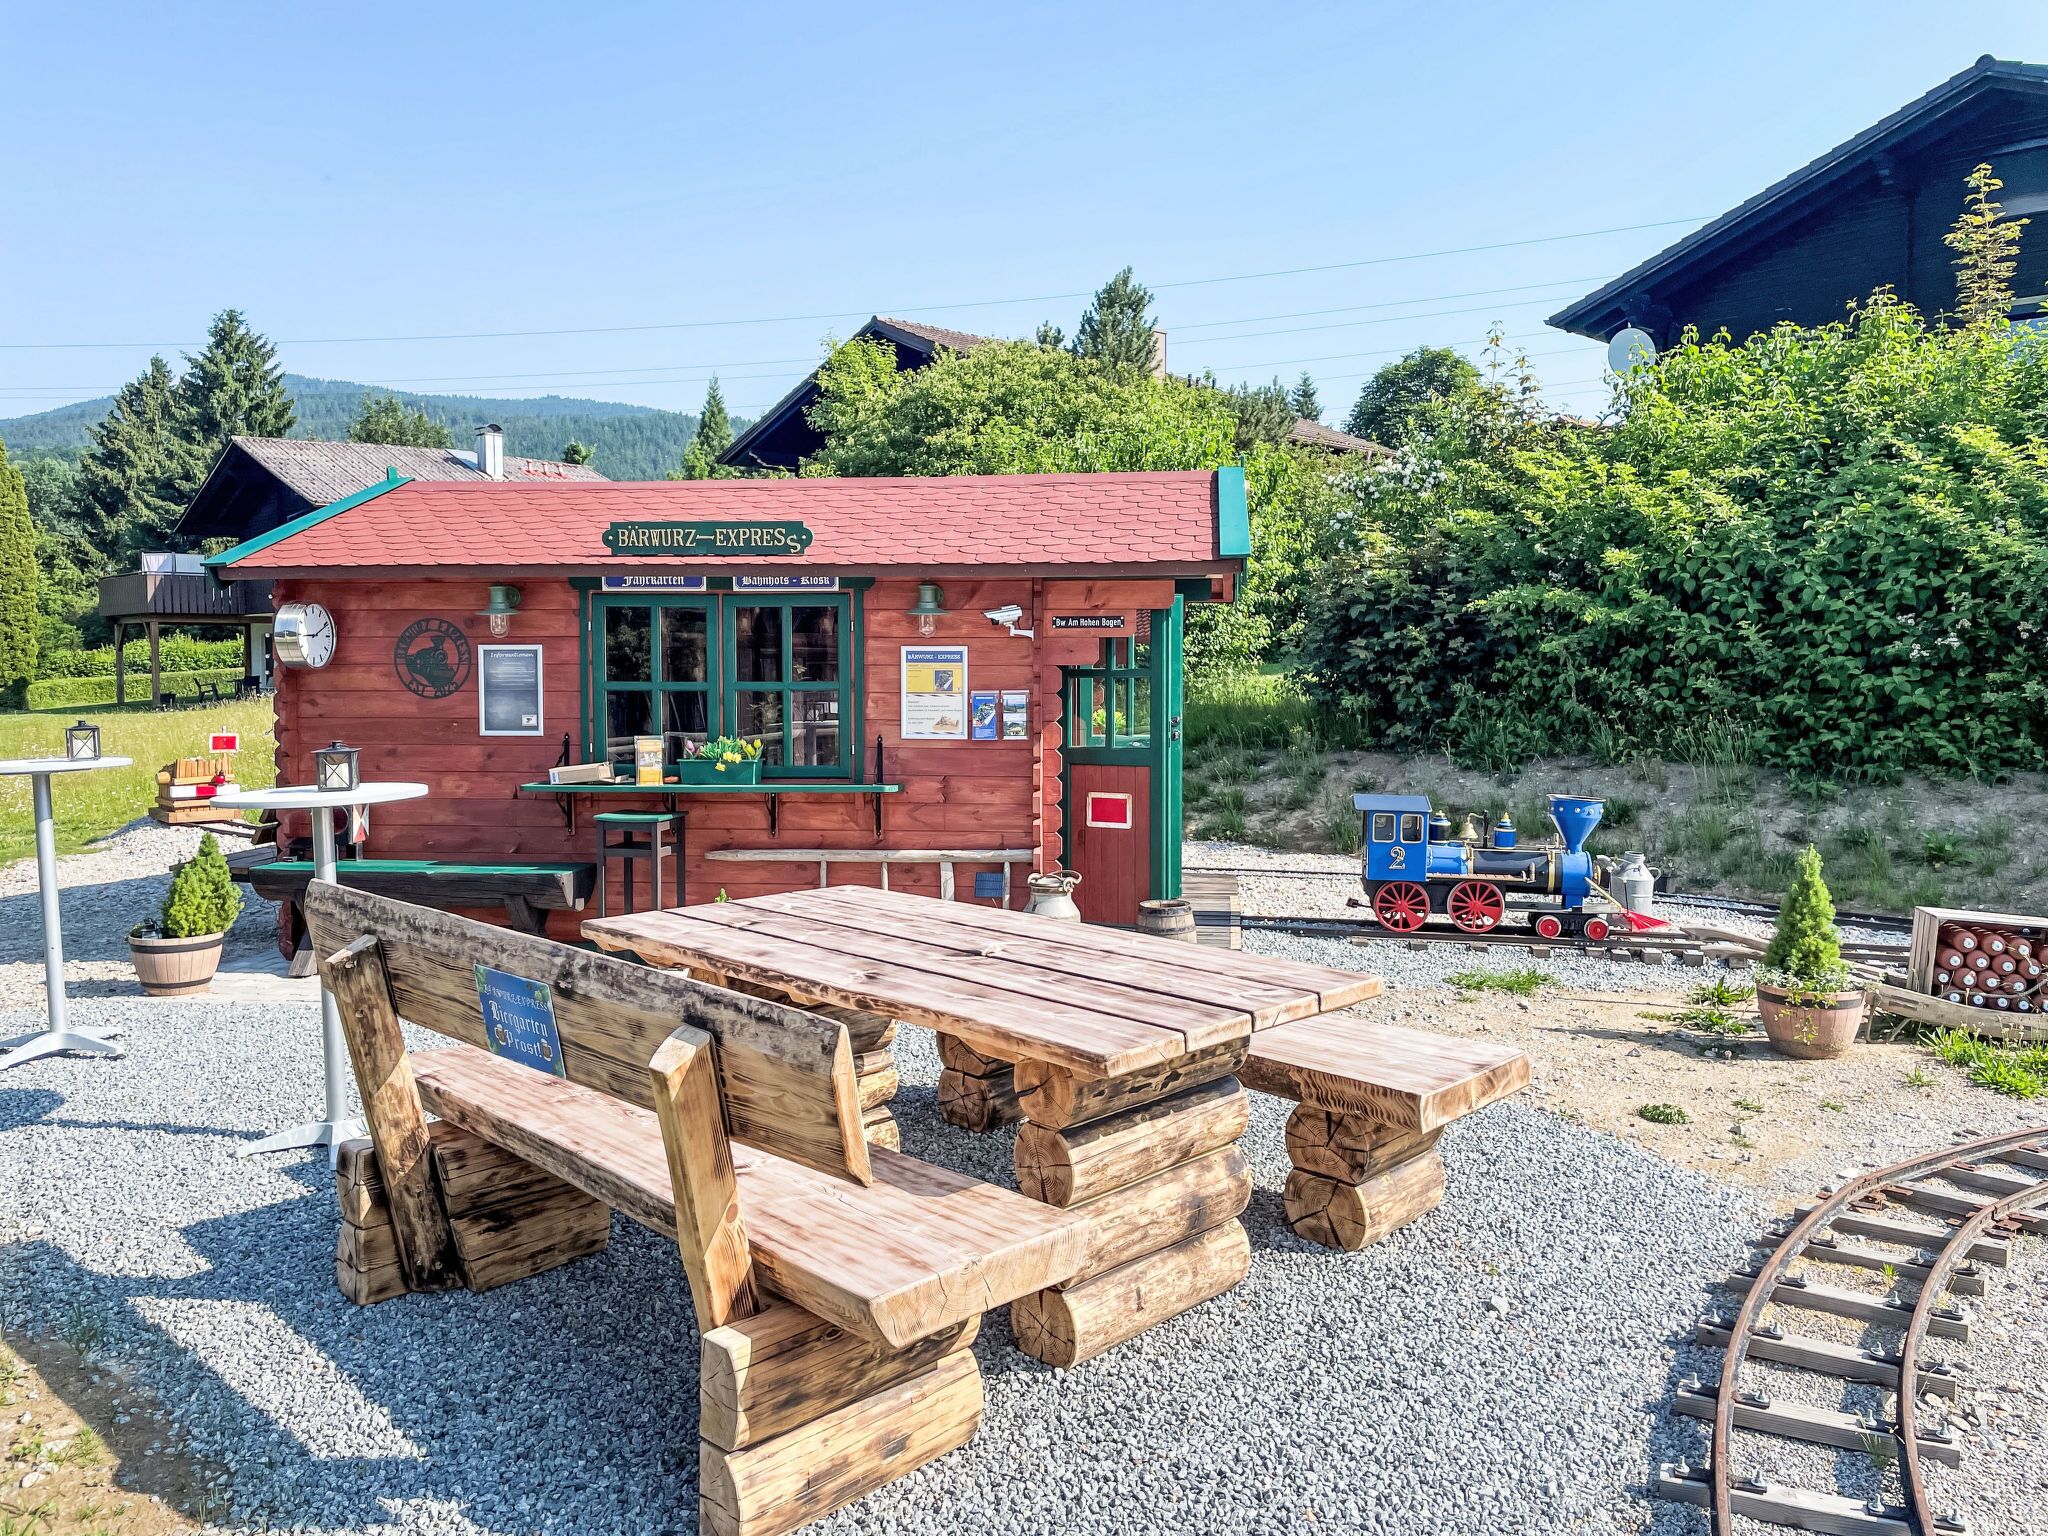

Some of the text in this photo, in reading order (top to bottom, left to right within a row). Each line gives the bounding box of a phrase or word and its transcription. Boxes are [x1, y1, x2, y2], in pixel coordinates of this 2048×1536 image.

[1068, 618, 1079, 626] Am
[1080, 618, 1100, 626] Hohen
[1101, 617, 1122, 628] Bogen
[1388, 846, 1406, 870] 2
[488, 1000, 548, 1037] Biergarten
